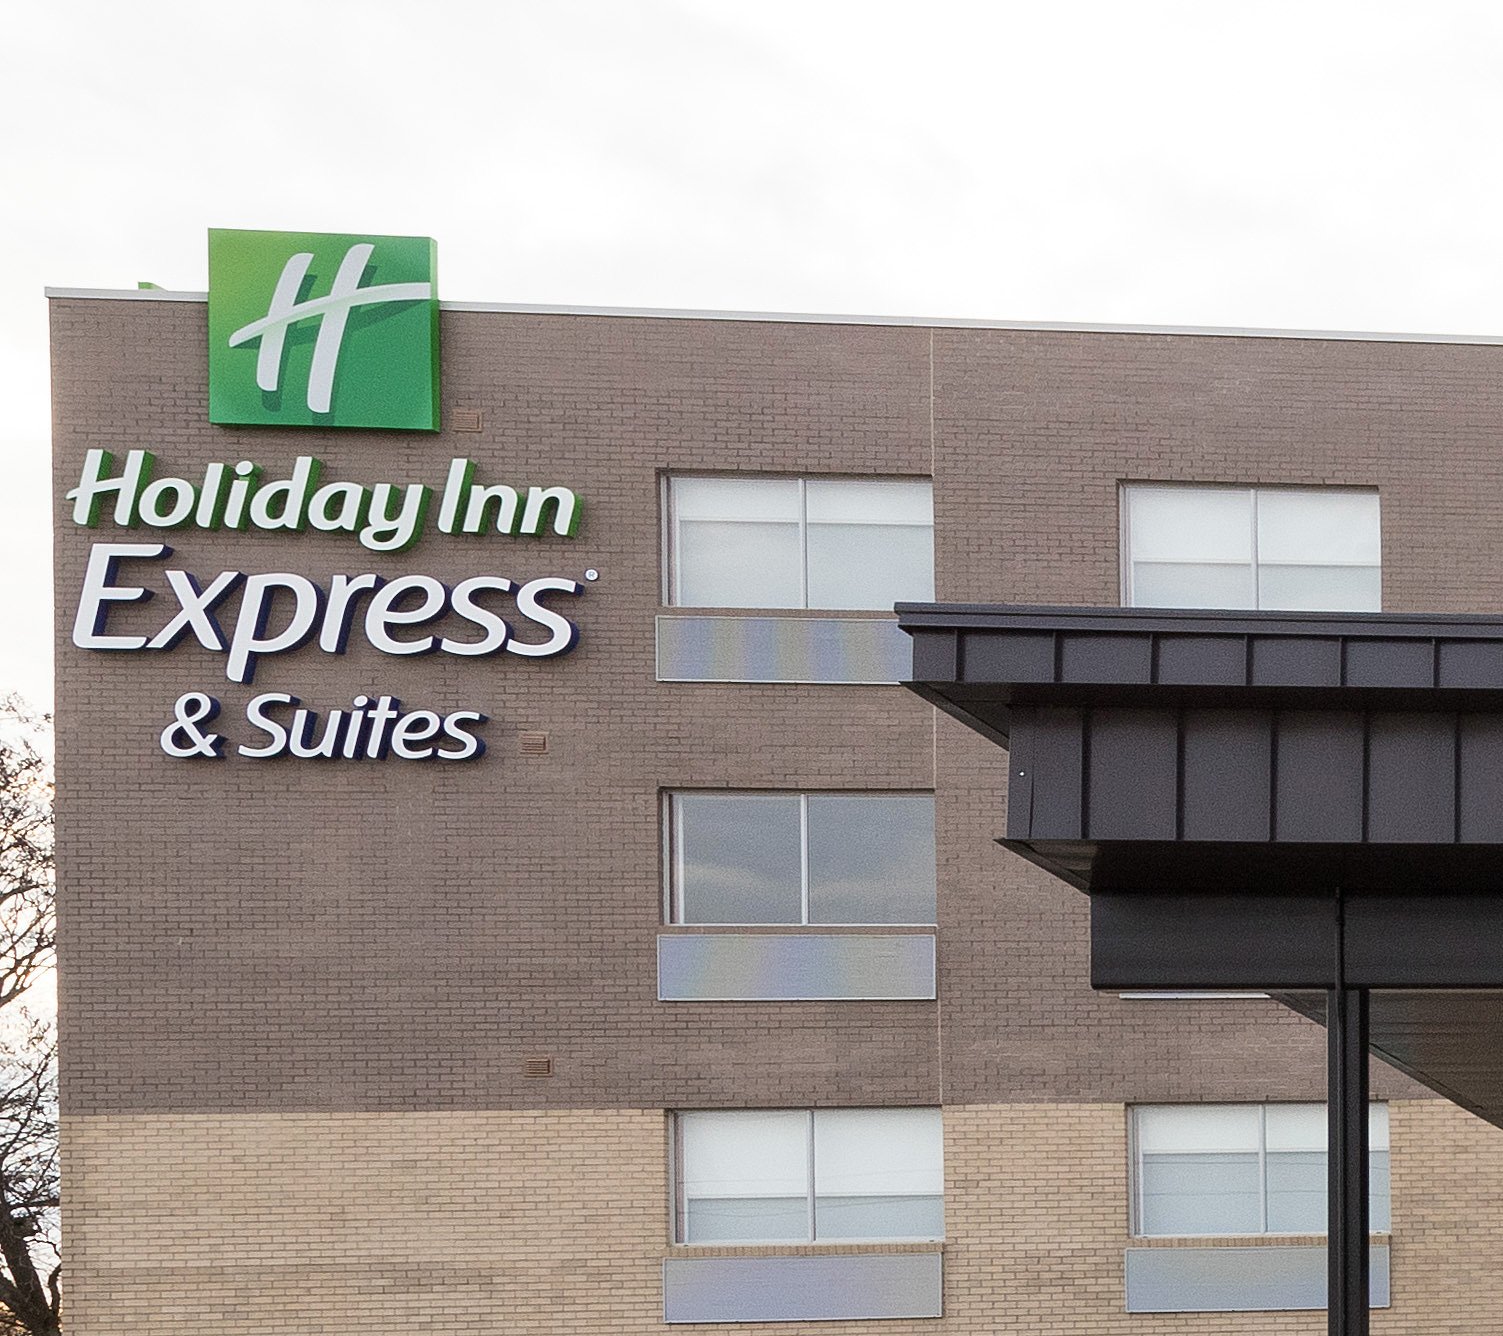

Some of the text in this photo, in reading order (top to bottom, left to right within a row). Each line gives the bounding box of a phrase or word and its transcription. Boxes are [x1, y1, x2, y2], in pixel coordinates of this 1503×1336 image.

[65, 448, 579, 551] Holiday Inn
[159, 691, 482, 760] & Suites
